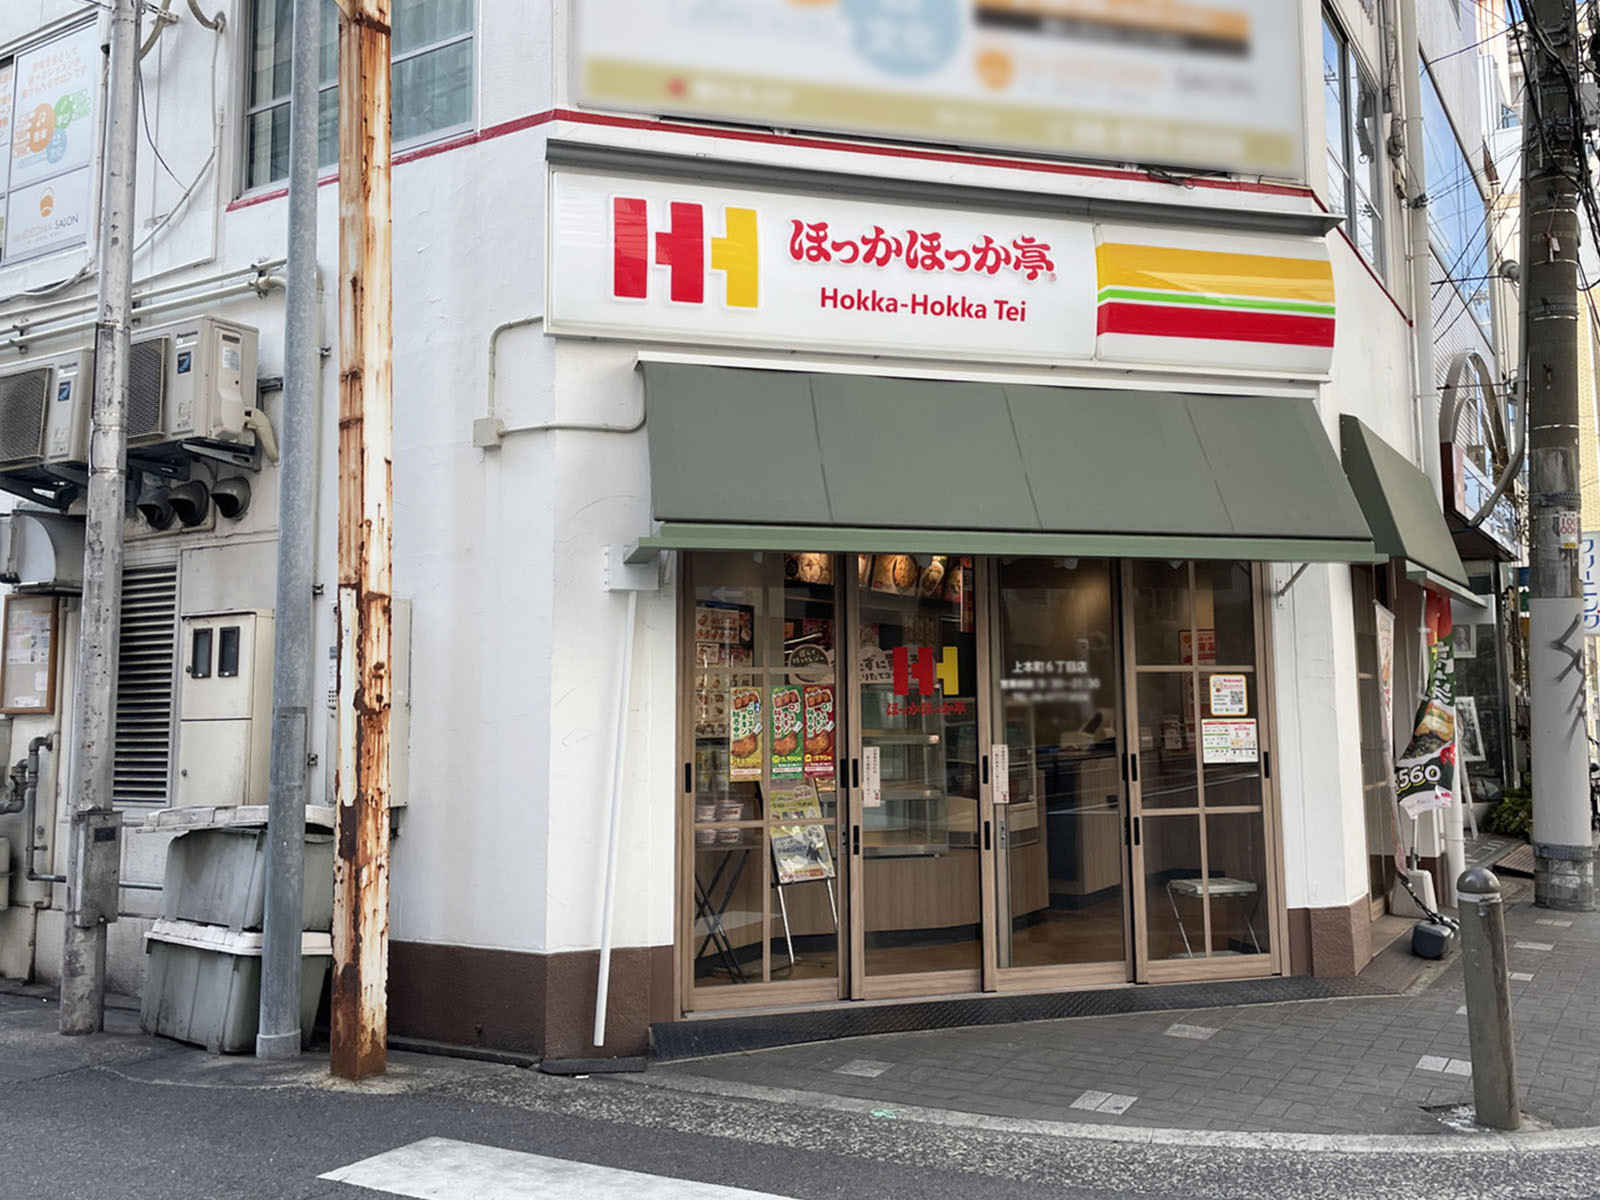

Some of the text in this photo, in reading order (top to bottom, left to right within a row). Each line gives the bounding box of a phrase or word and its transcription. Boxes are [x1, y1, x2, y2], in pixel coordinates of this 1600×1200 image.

[789, 219, 1049, 281] ほっかほっか亭
[821, 287, 1026, 322] Hokka-Hokka Tei
[886, 701, 967, 717] ほっかほっか亭
[1399, 765, 1441, 788] 560
